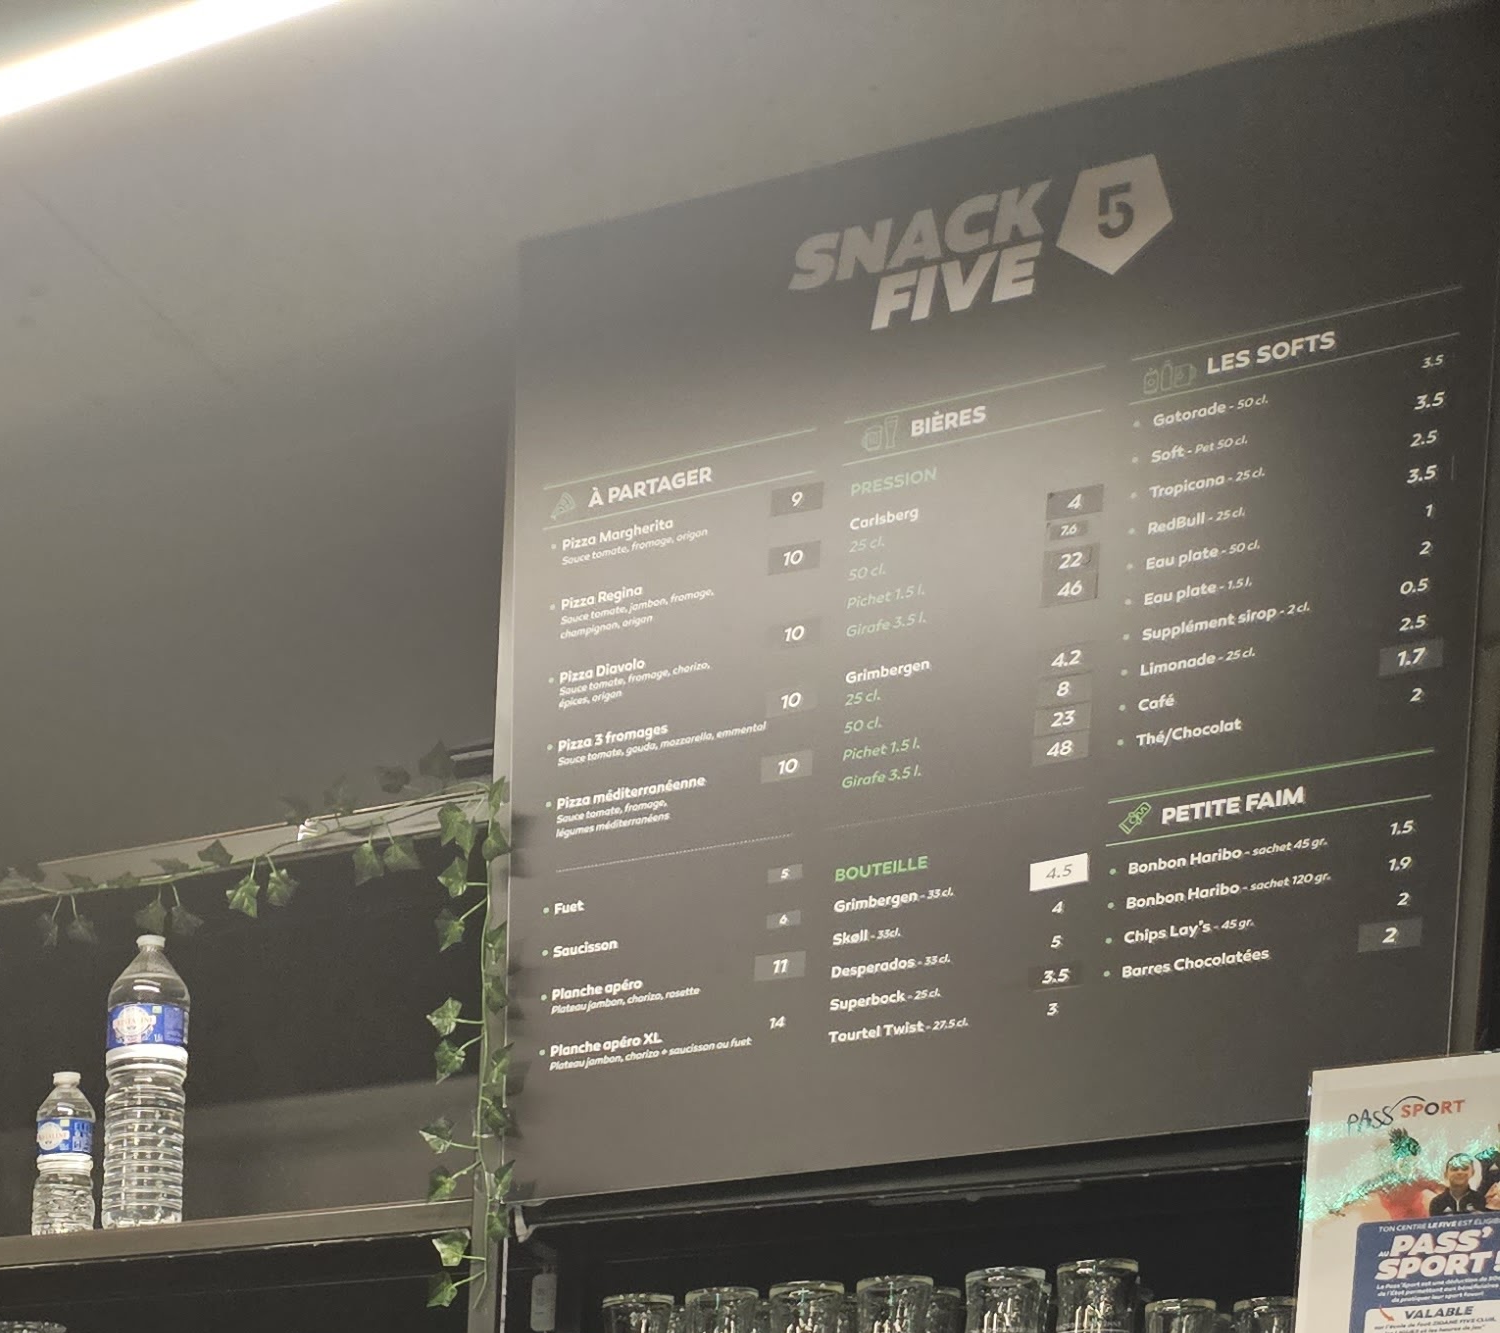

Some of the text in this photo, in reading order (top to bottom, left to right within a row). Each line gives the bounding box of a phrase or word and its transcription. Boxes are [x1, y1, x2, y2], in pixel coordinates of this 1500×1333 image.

[1097, 180, 1135, 241] 5
[788, 178, 1052, 291] SNACK
[870, 243, 1041, 331] FIVE
[1207, 331, 1336, 376] LES SOFTS
[1421, 354, 1444, 369] 3.5
[1414, 391, 1445, 411] 3.5
[911, 406, 986, 438] BIÈRES
[1153, 402, 1226, 427] Gatorade
[1410, 430, 1438, 447] 2.5
[1151, 445, 1185, 463] Soft
[851, 467, 937, 496] PRESSION
[1406, 464, 1437, 483] 3.5
[588, 467, 712, 508] À PARTAGER
[1149, 473, 1225, 498] Tropicana
[791, 492, 803, 506] 9
[1067, 494, 1082, 510] 4
[850, 508, 919, 530] Carlsberg
[1425, 504, 1433, 518] 1
[1060, 525, 1077, 536] 7.6
[1147, 511, 1205, 535] RedBull
[562, 519, 674, 551] Pizza Margherita
[783, 550, 803, 566] 10
[1146, 545, 1219, 570] Eau plate
[1419, 541, 1432, 555] 2
[1058, 552, 1082, 570] 22
[1057, 580, 1082, 597] 46
[1144, 582, 1216, 606] Eau plate
[1400, 578, 1429, 595] 0.5
[561, 585, 643, 611] Pizza Regina
[785, 625, 805, 641] 10
[1142, 606, 1277, 641] Supplément sirop
[1399, 615, 1427, 632] 2.5
[1051, 649, 1082, 668] 4.2
[1140, 652, 1216, 676] Limonade
[1397, 647, 1426, 667] 1.7
[559, 658, 645, 684] Pizza Diavolo
[845, 660, 930, 684] Grimbergen
[1056, 681, 1070, 697] 8
[1410, 688, 1423, 702] 2
[780, 692, 801, 709] 10
[1138, 693, 1175, 711] Café
[1051, 710, 1076, 727] 23
[558, 723, 668, 752] Pizza 3 fromages
[1136, 718, 1242, 747] Thé/Chocolat
[557, 755, 585, 766] Sauce
[587, 747, 624, 763] tomate,
[626, 742, 658, 757] gouda,
[716, 721, 767, 739] emmental
[1046, 740, 1073, 757] 48
[777, 758, 798, 775] 10
[556, 775, 706, 811] Pizza méditerranéenne
[1162, 786, 1305, 825] PETITE FAIM
[1389, 820, 1414, 836] 1.5
[1128, 857, 1187, 875] Bonbon
[1190, 848, 1242, 866] Haribo
[1252, 841, 1292, 856] sachet
[1293, 838, 1310, 849] 45
[1388, 857, 1412, 872] 1.9
[835, 855, 928, 882] BOUTEILLE
[1046, 864, 1072, 880] 4.5
[554, 900, 584, 915] Fuet
[833, 890, 918, 913] Grimbergen
[1052, 901, 1065, 914] 4
[1397, 892, 1410, 906] 2
[1051, 935, 1062, 949] 5
[1124, 919, 1211, 945] Chips Lay's
[1382, 927, 1398, 944] 2
[553, 939, 618, 958] Saucisson
[773, 959, 788, 975] 11
[831, 957, 916, 979] Desperados
[1122, 947, 1270, 979] Barres Chocolatées
[1042, 968, 1070, 985] 3.5
[552, 978, 643, 1002] Planche apéro
[830, 990, 906, 1012] Superbock
[1047, 1003, 1059, 1016] 3
[769, 1016, 785, 1030] 14
[829, 1020, 925, 1043] Tourtel Twist
[550, 1032, 662, 1057] Planche apéro XL
[1347, 1099, 1465, 1134] PASS SPORT
[1389, 1226, 1493, 1257] PASS'
[1374, 1250, 1493, 1280] SPORT
[1405, 1306, 1474, 1320] VALABLE
